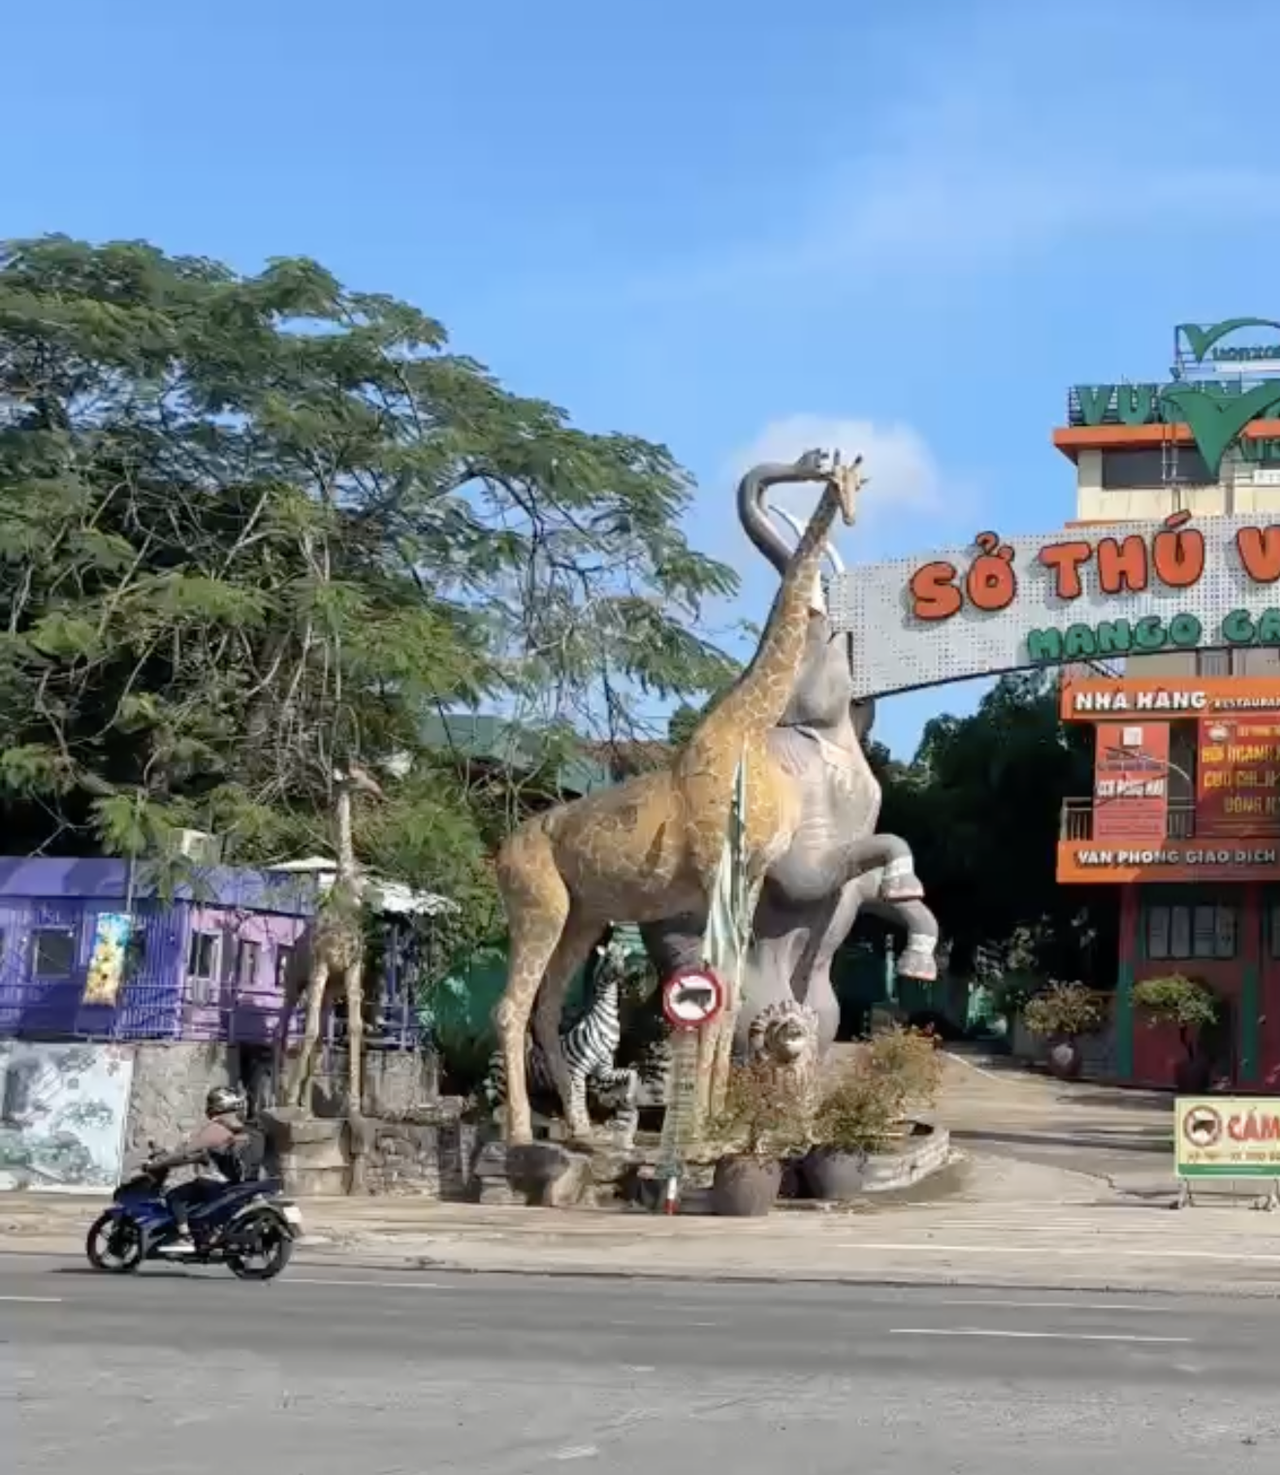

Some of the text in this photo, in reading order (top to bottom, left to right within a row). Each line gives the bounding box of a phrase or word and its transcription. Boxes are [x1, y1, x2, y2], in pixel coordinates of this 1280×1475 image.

[909, 531, 1017, 621] SỞ
[1038, 509, 1206, 600] THÚ
[1027, 612, 1202, 661] MANGO
[1186, 849, 1229, 863] GIAO
